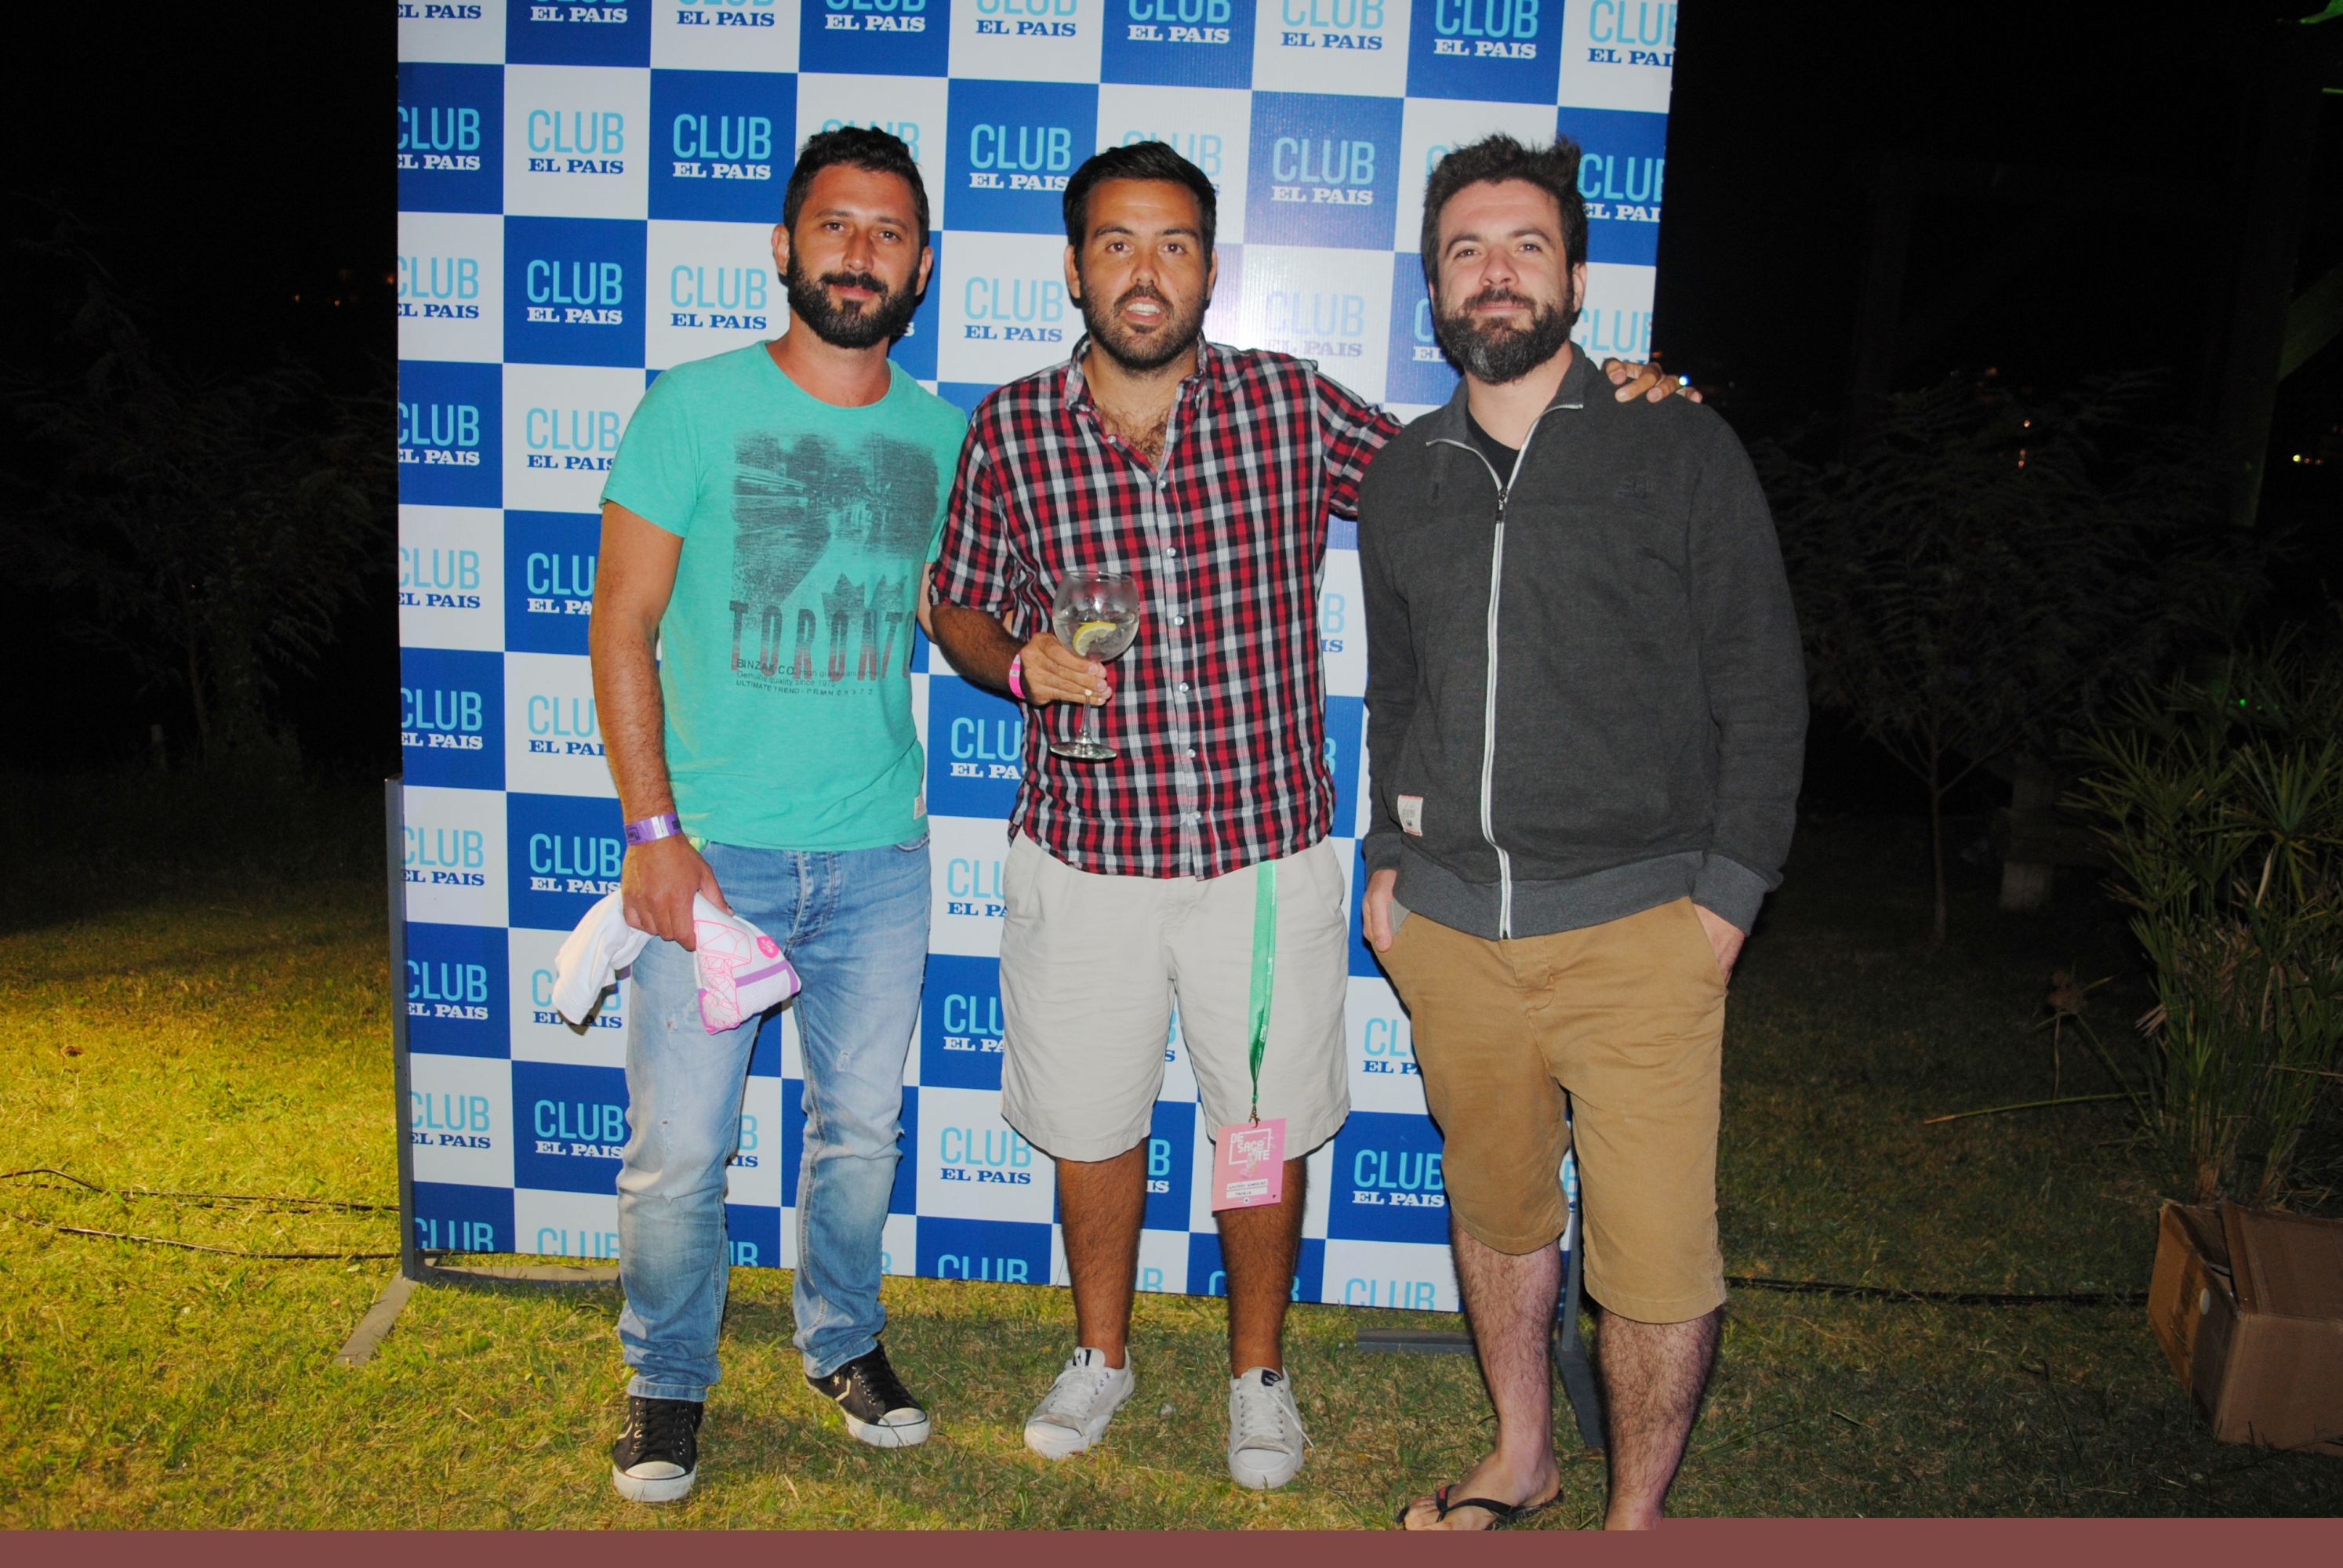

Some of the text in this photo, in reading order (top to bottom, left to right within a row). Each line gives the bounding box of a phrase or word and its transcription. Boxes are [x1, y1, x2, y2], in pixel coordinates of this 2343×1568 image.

[424, 5, 482, 19] PAIS
[530, 7, 627, 22] EL PAIS
[676, 11, 776, 27] EL PAIS
[1283, 0, 1385, 30] CLUB
[1436, 0, 1538, 38] CLUB
[825, 15, 925, 31] EL PAIS
[976, 20, 1077, 36] EL PAIS
[1128, 25, 1230, 43] EL PAIS
[1281, 33, 1382, 49] EL PAIS
[1433, 39, 1537, 58] EL PAIS
[1588, 49, 1673, 67] EL PAI
[528, 109, 624, 154] CLUB
[674, 114, 771, 160] CLUB
[970, 124, 1072, 172] CLUB
[423, 155, 481, 169] PAIS
[528, 158, 624, 174] EL PAIS
[1273, 137, 1375, 186] CLUB
[673, 162, 771, 179] EL PAIS
[968, 172, 1070, 191] EL PAIS
[1272, 187, 1373, 205] EL PAIS
[1615, 205, 1661, 222] PAI
[528, 260, 622, 305] CLUB
[670, 265, 767, 310] CLUB
[965, 277, 1063, 321] CLUB
[423, 304, 480, 318] PAIS
[527, 307, 623, 324] EL PAIS
[1265, 290, 1364, 336] CLUB
[670, 314, 767, 329] EL PAIS
[965, 326, 1062, 341] EL PAIS
[1302, 340, 1362, 357] PAIS
[526, 408, 620, 452] CLUB
[423, 450, 480, 465] PAIS
[527, 455, 559, 468] EL
[528, 553, 594, 597] CLU
[426, 593, 481, 608] PAIS
[527, 598, 594, 615] EL PA
[736, 670, 768, 683] Genuine
[768, 677, 794, 688] quality
[736, 680, 772, 691] ULTIMATE
[773, 686, 800, 695] TREND
[528, 695, 595, 738] CLU
[428, 734, 483, 750] PAIS
[951, 717, 1023, 761] CLU
[529, 740, 605, 756] EL PAI
[950, 763, 1022, 779] EL PA
[530, 833, 621, 877] CLUB
[431, 872, 485, 886] PAIS
[530, 877, 621, 895] EL PAIS
[947, 858, 1005, 900] CLU
[947, 902, 979, 915] EL
[434, 1004, 489, 1019] PAIS
[532, 1011, 563, 1025] EL
[944, 994, 1004, 1036] CLU
[943, 1037, 1004, 1053] EL PA
[1363, 1061, 1394, 1073] EL
[535, 1100, 623, 1142] CLUB
[439, 1134, 491, 1149] PAIS
[940, 1127, 1032, 1168] CLUB
[535, 1142, 624, 1159] EL PAIS
[940, 1168, 1031, 1184] EL PAIS
[1354, 1149, 1443, 1190] CLUB
[1353, 1192, 1445, 1207] EL PAIS
